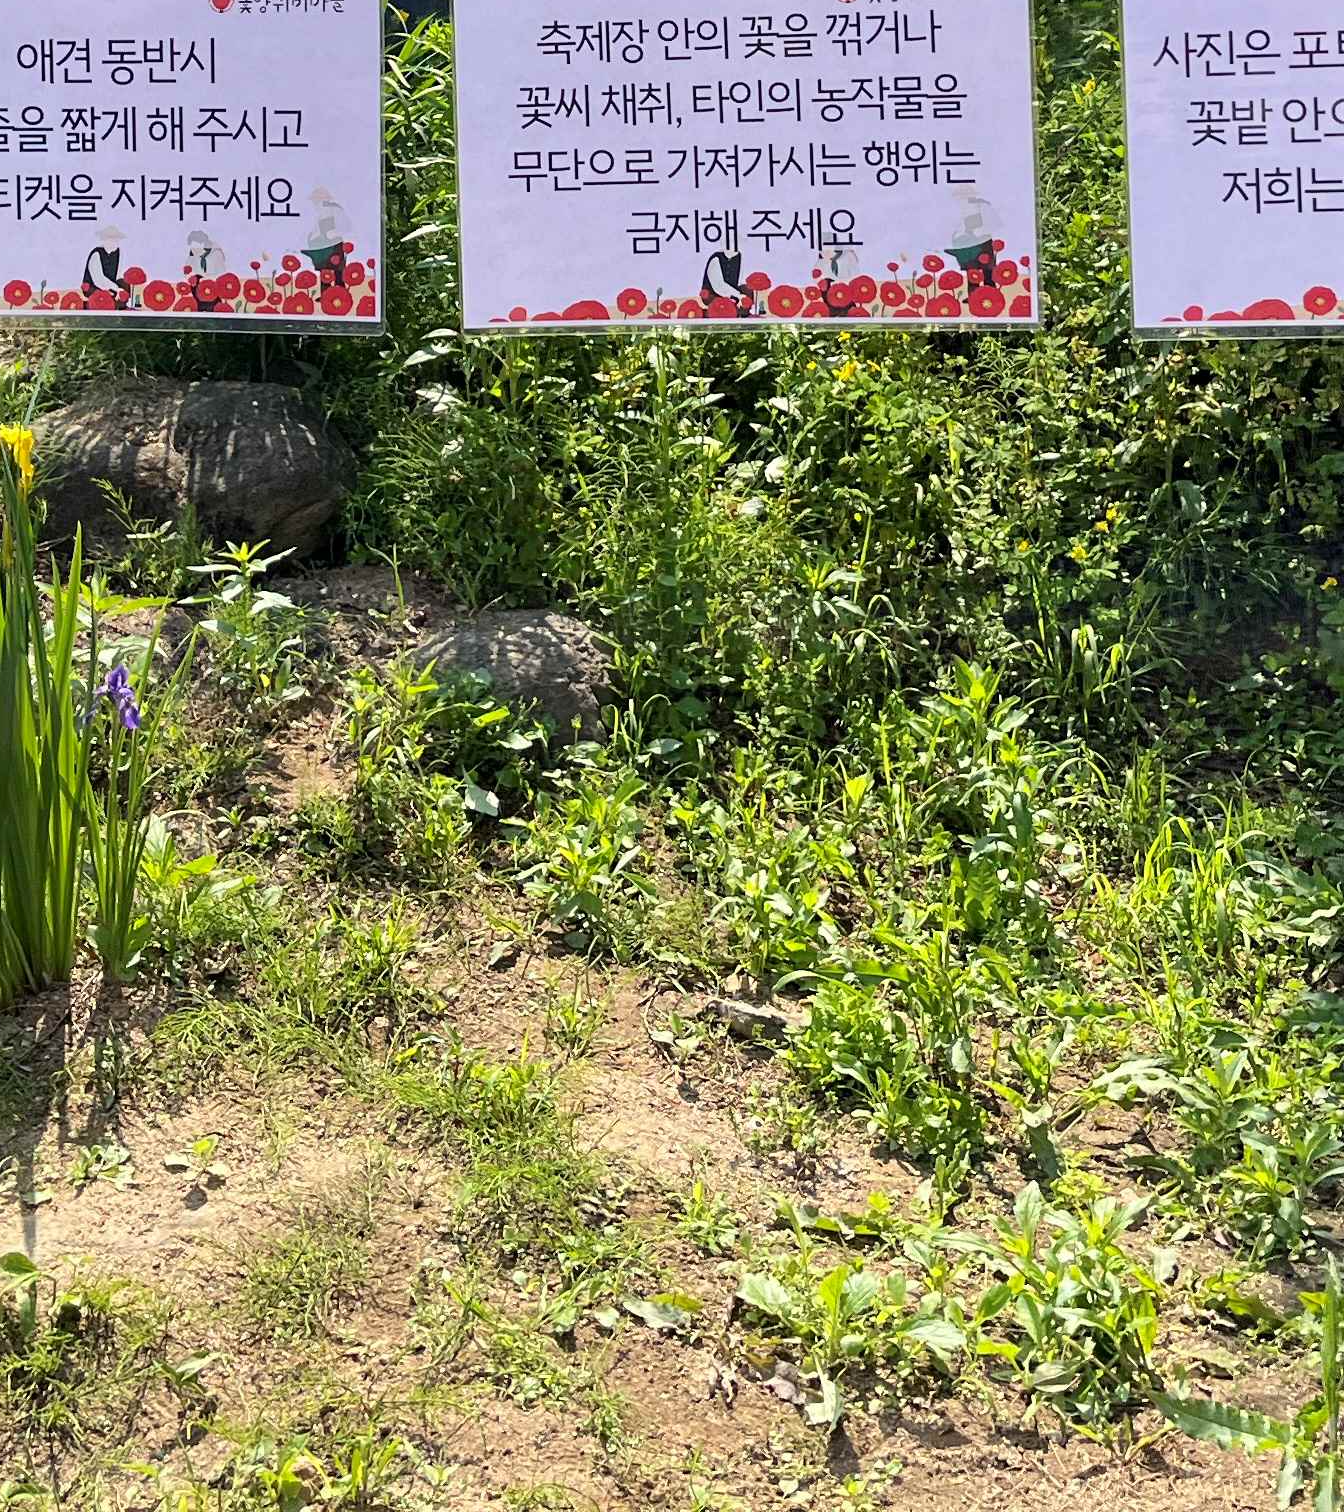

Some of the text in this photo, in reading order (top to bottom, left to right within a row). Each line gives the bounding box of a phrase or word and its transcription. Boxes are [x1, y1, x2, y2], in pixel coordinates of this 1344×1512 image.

[16, 37, 217, 85] 애견 동반시
[535, 9, 943, 65] 축제장 안의 꽃을 꺾거나
[1153, 28, 1282, 78] 사진은
[516, 72, 968, 129] 꽃씨 채취, 타인의 농작물을
[1185, 96, 1273, 148] 꽃밭
[60, 106, 138, 153] 짧게
[146, 107, 184, 152] 해
[192, 106, 310, 153] 주시고
[508, 140, 981, 193] 무단으로 가져가시는 행위는
[111, 175, 301, 223] 지켜주세요
[625, 207, 864, 254] 금지해 주세요
